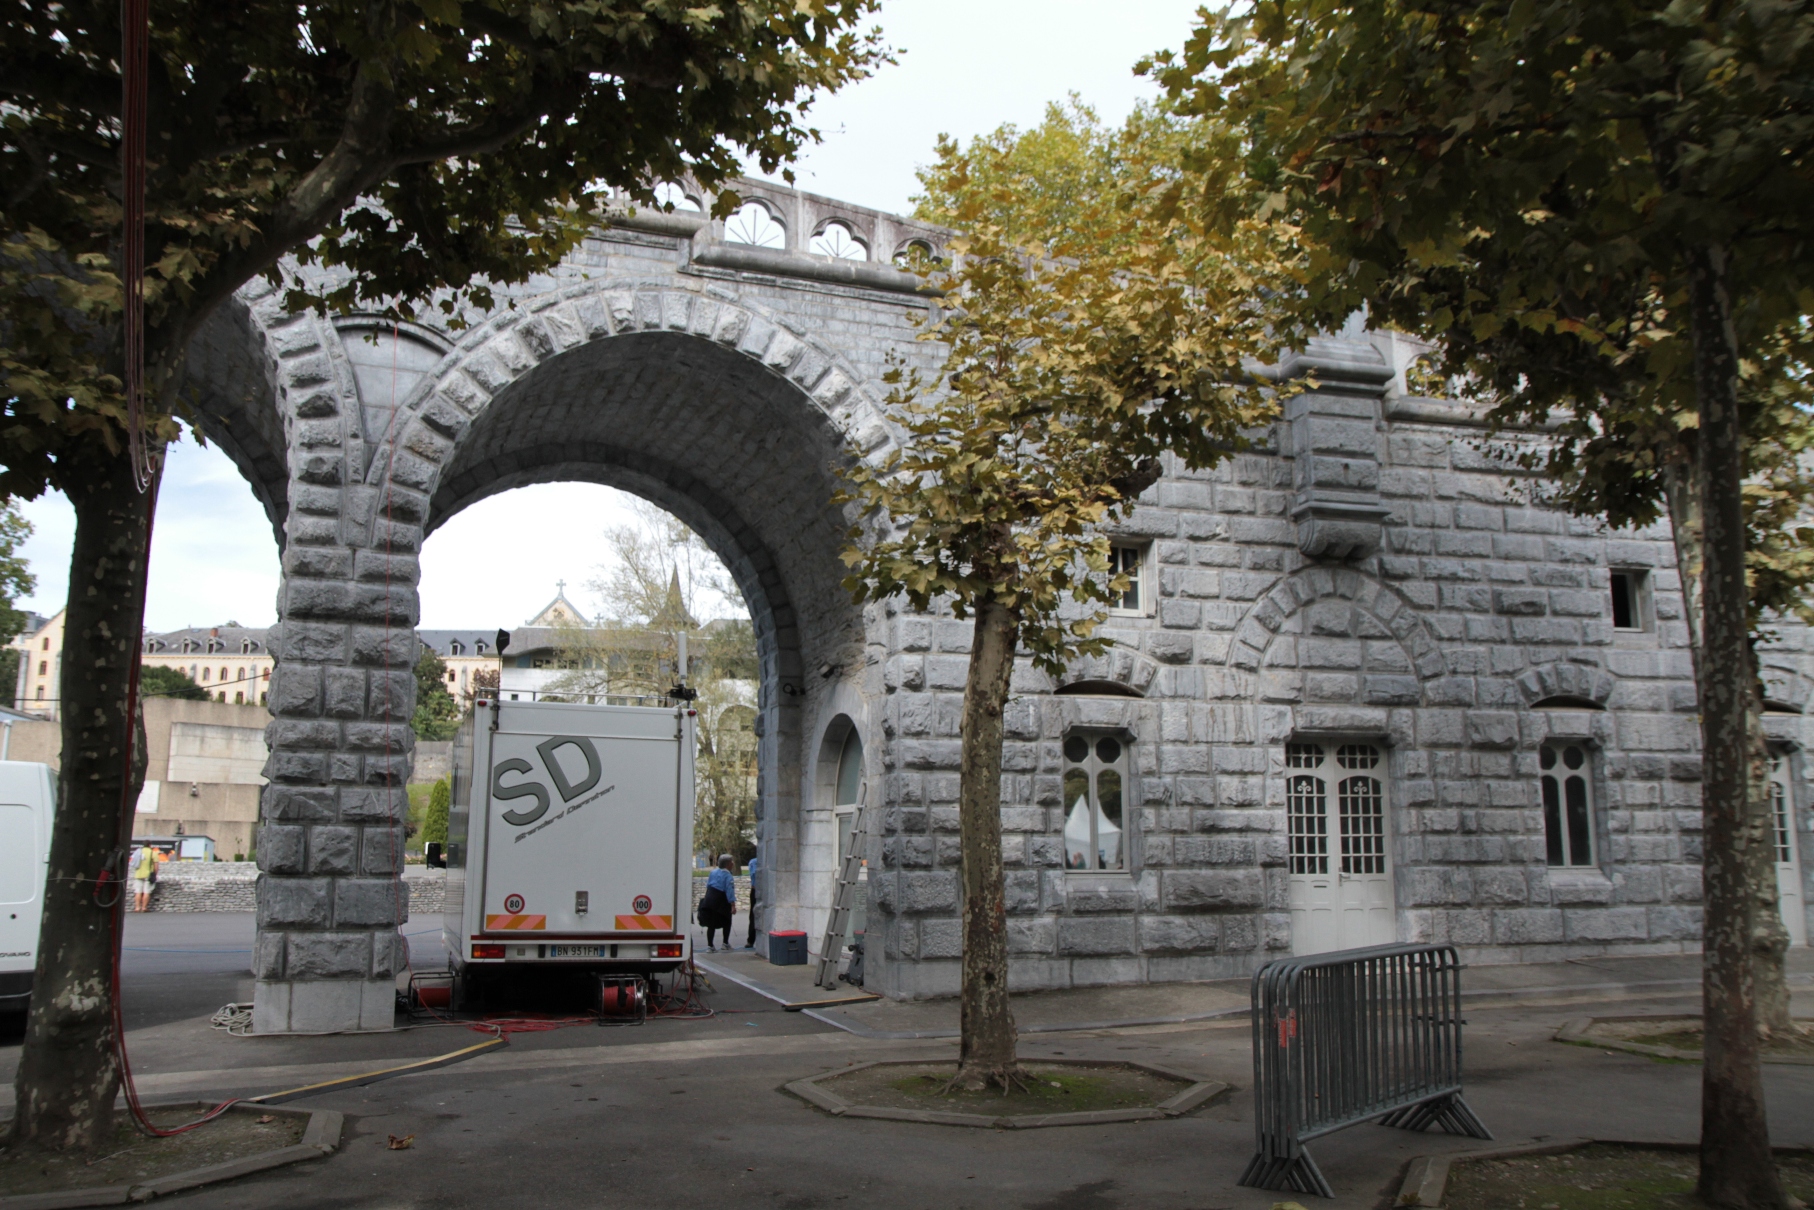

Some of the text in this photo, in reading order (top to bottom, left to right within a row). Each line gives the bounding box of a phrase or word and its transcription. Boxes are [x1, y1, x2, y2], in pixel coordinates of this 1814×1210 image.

[492, 735, 602, 827] SD
[514, 784, 615, 844] Standard Definition
[509, 899, 520, 909] 80
[636, 900, 649, 909] 100
[557, 946, 569, 956] BN
